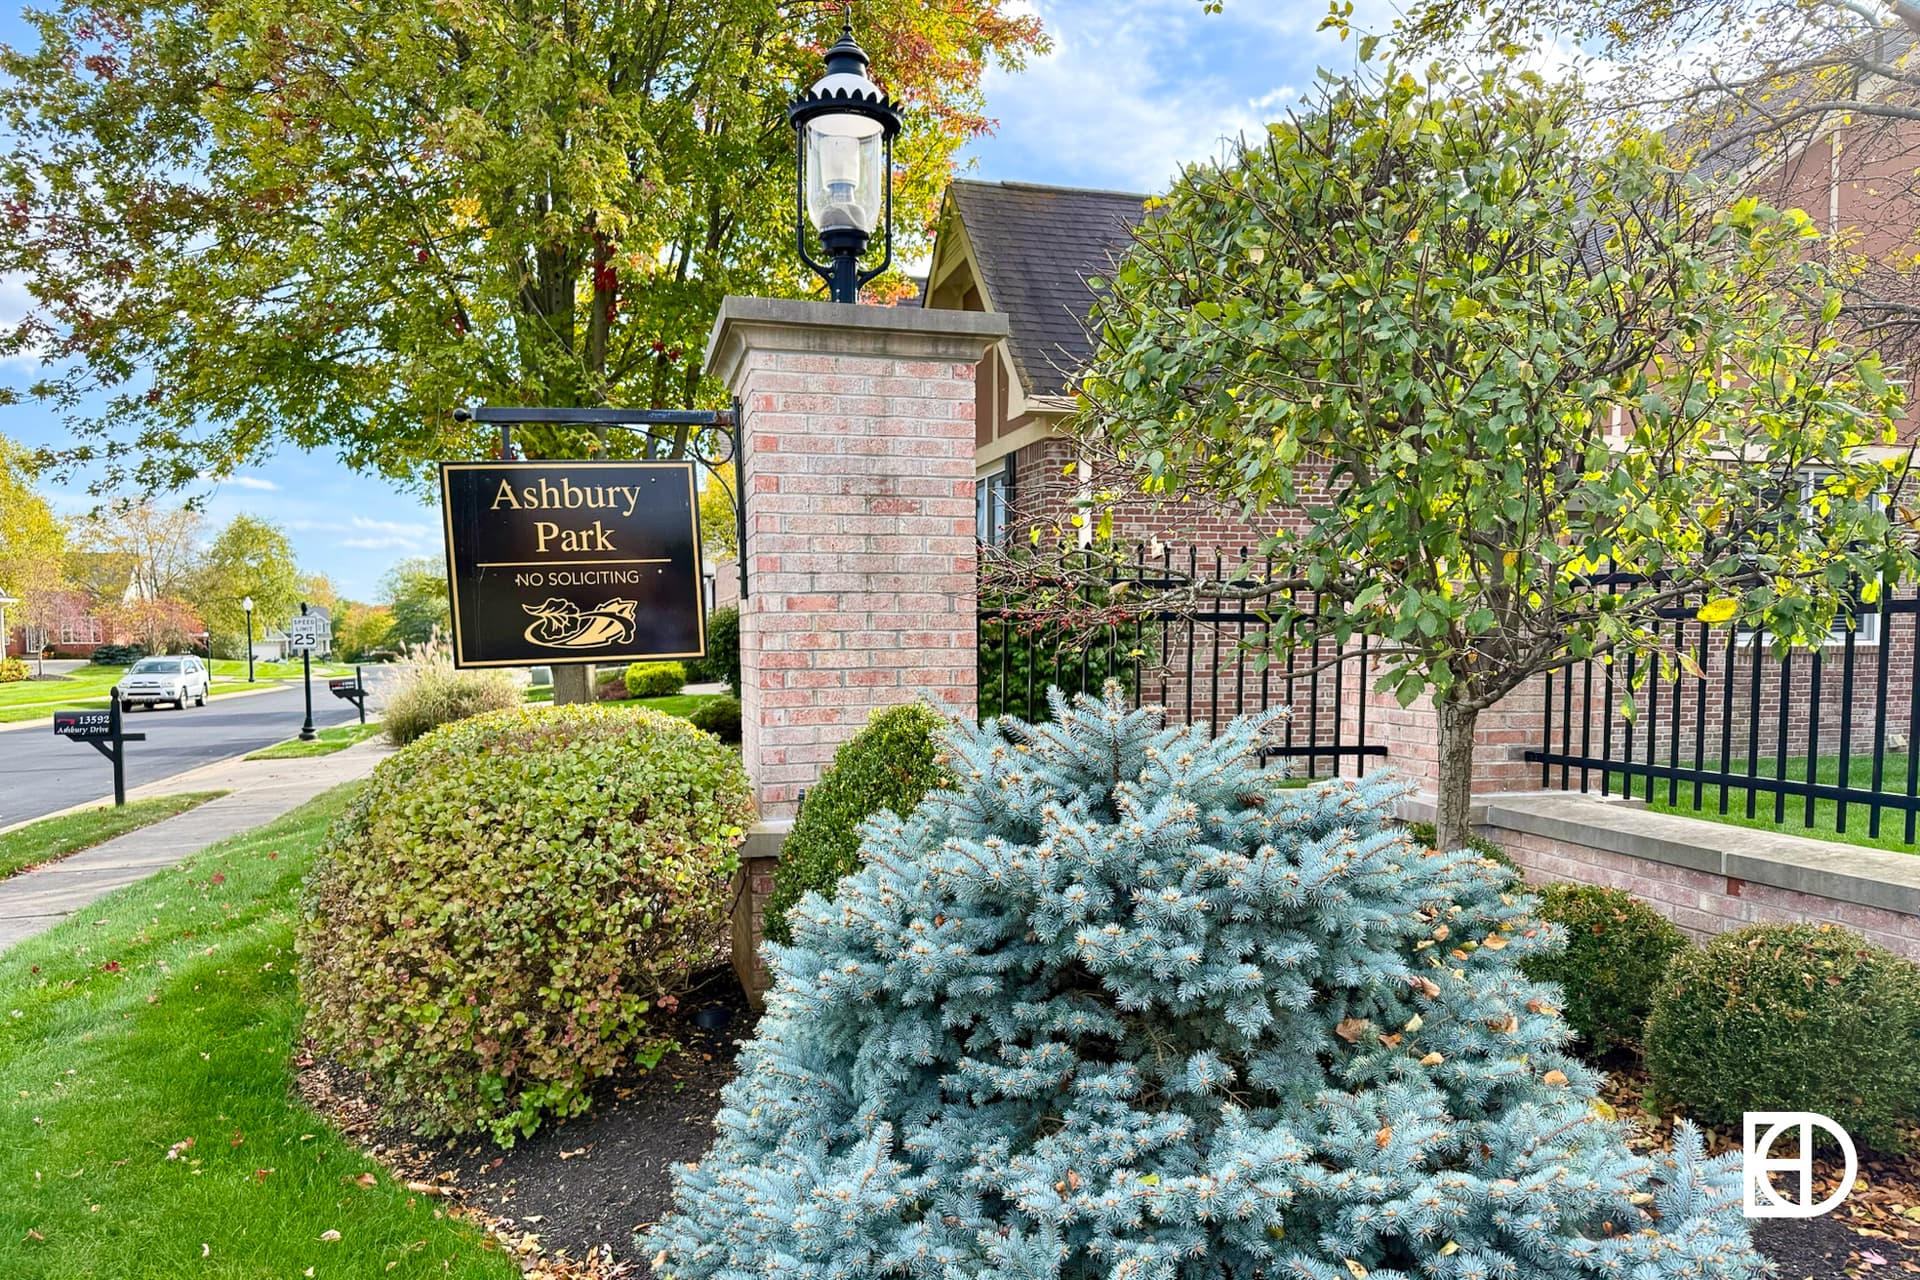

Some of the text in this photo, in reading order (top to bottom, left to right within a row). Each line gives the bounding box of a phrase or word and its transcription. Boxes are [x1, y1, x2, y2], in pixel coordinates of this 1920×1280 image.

[490, 477, 641, 517] Ashbury
[533, 521, 618, 553] Park
[517, 570, 640, 587] NO SOLICITING
[294, 633, 316, 645] 25
[79, 715, 110, 725] 13592
[90, 726, 110, 734] Drive
